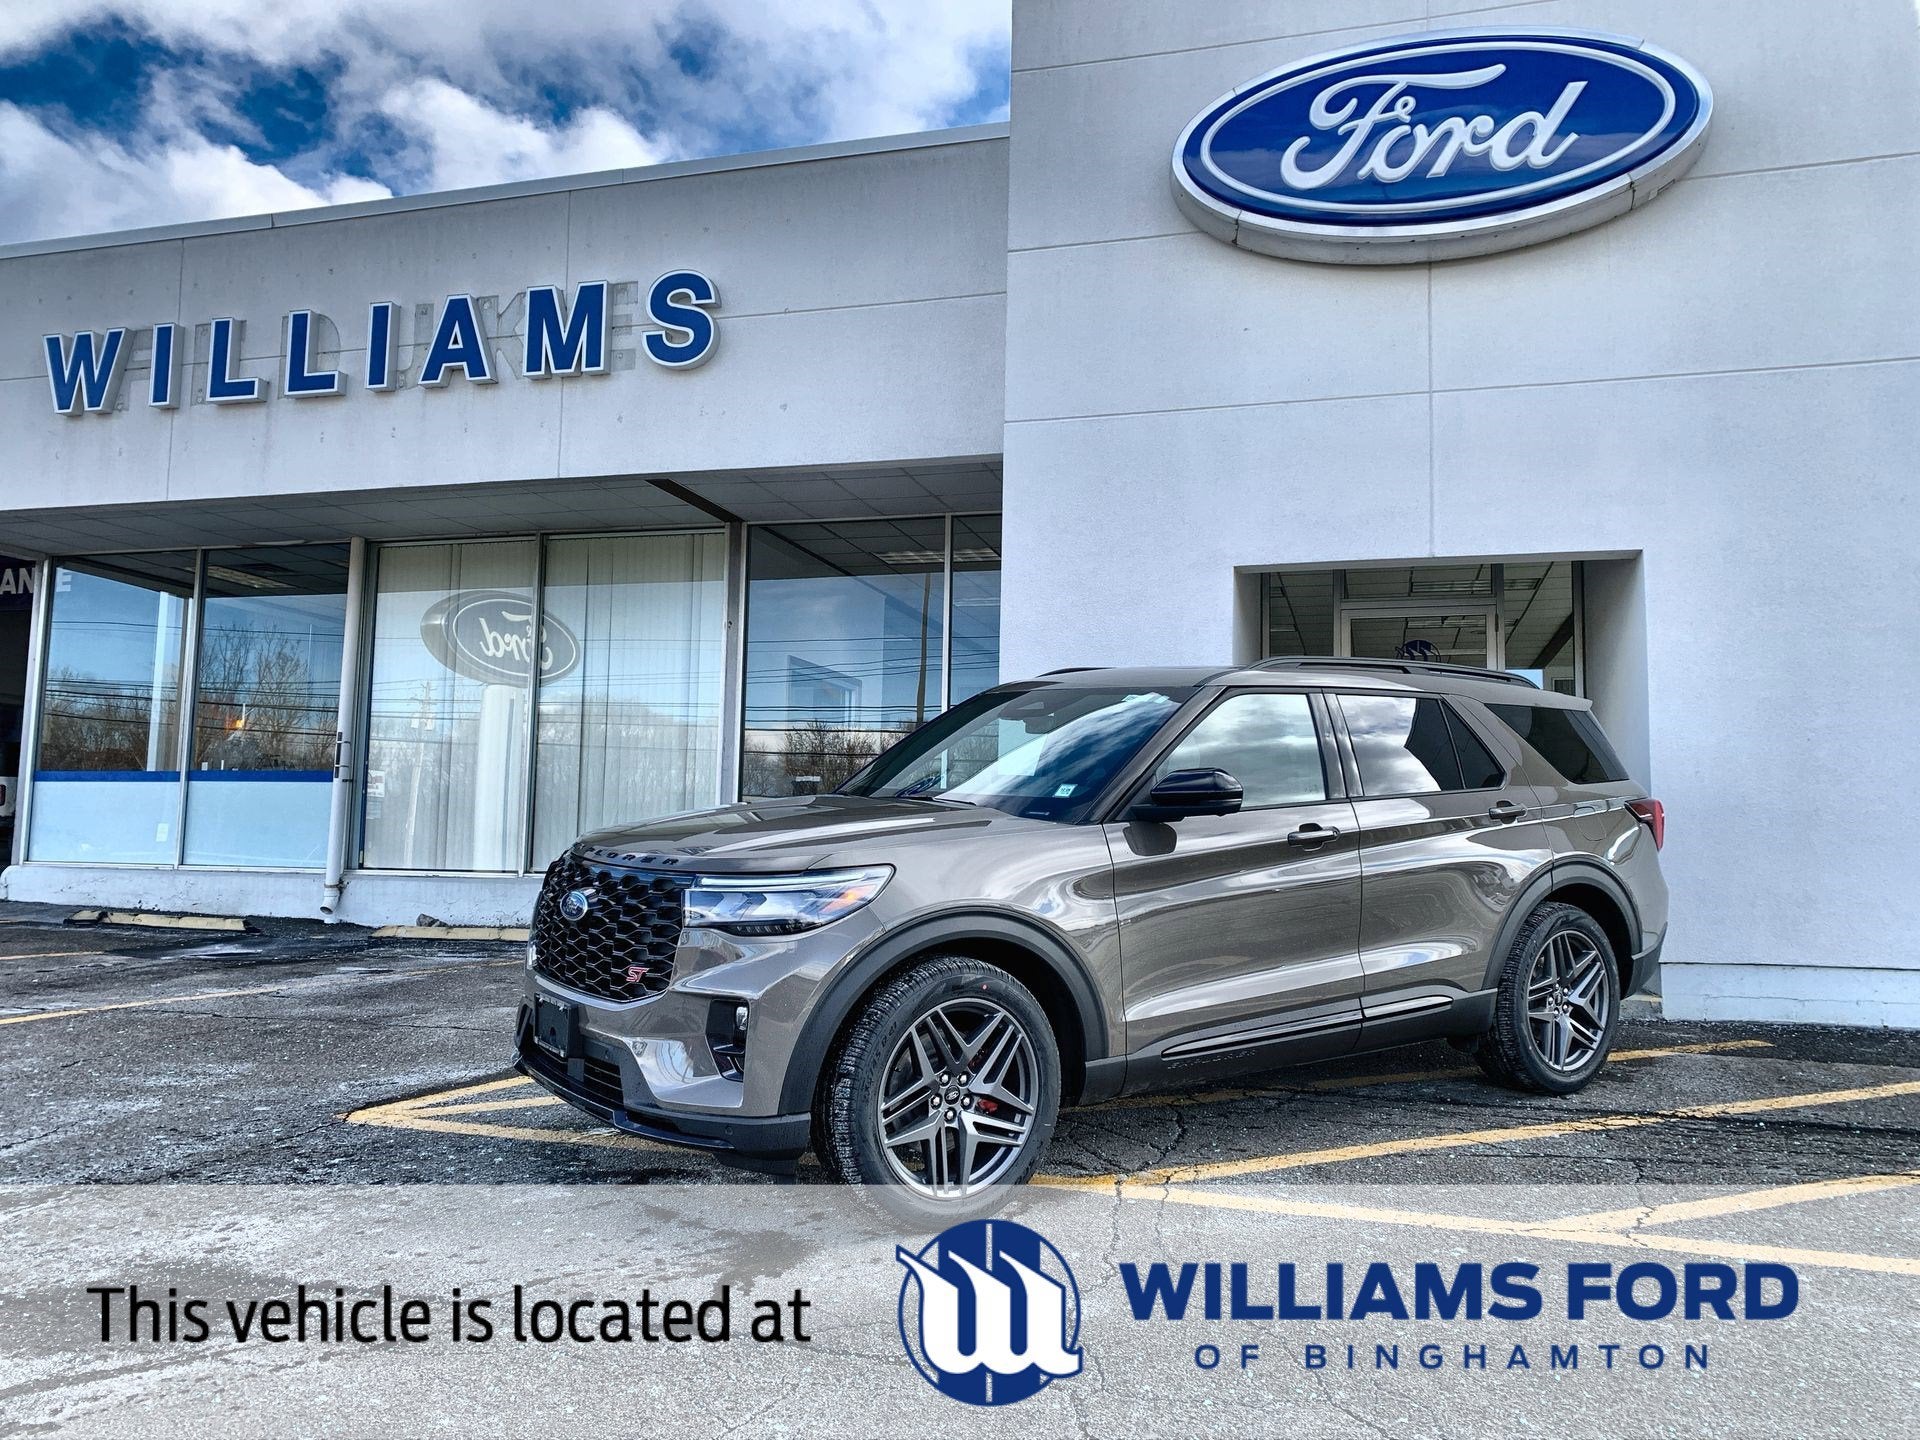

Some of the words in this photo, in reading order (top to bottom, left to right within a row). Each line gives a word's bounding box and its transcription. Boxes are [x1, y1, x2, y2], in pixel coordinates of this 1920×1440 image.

[1280, 64, 1588, 190] Ford
[43, 270, 718, 415] WILLIAMS
[626, 966, 649, 982] ST
